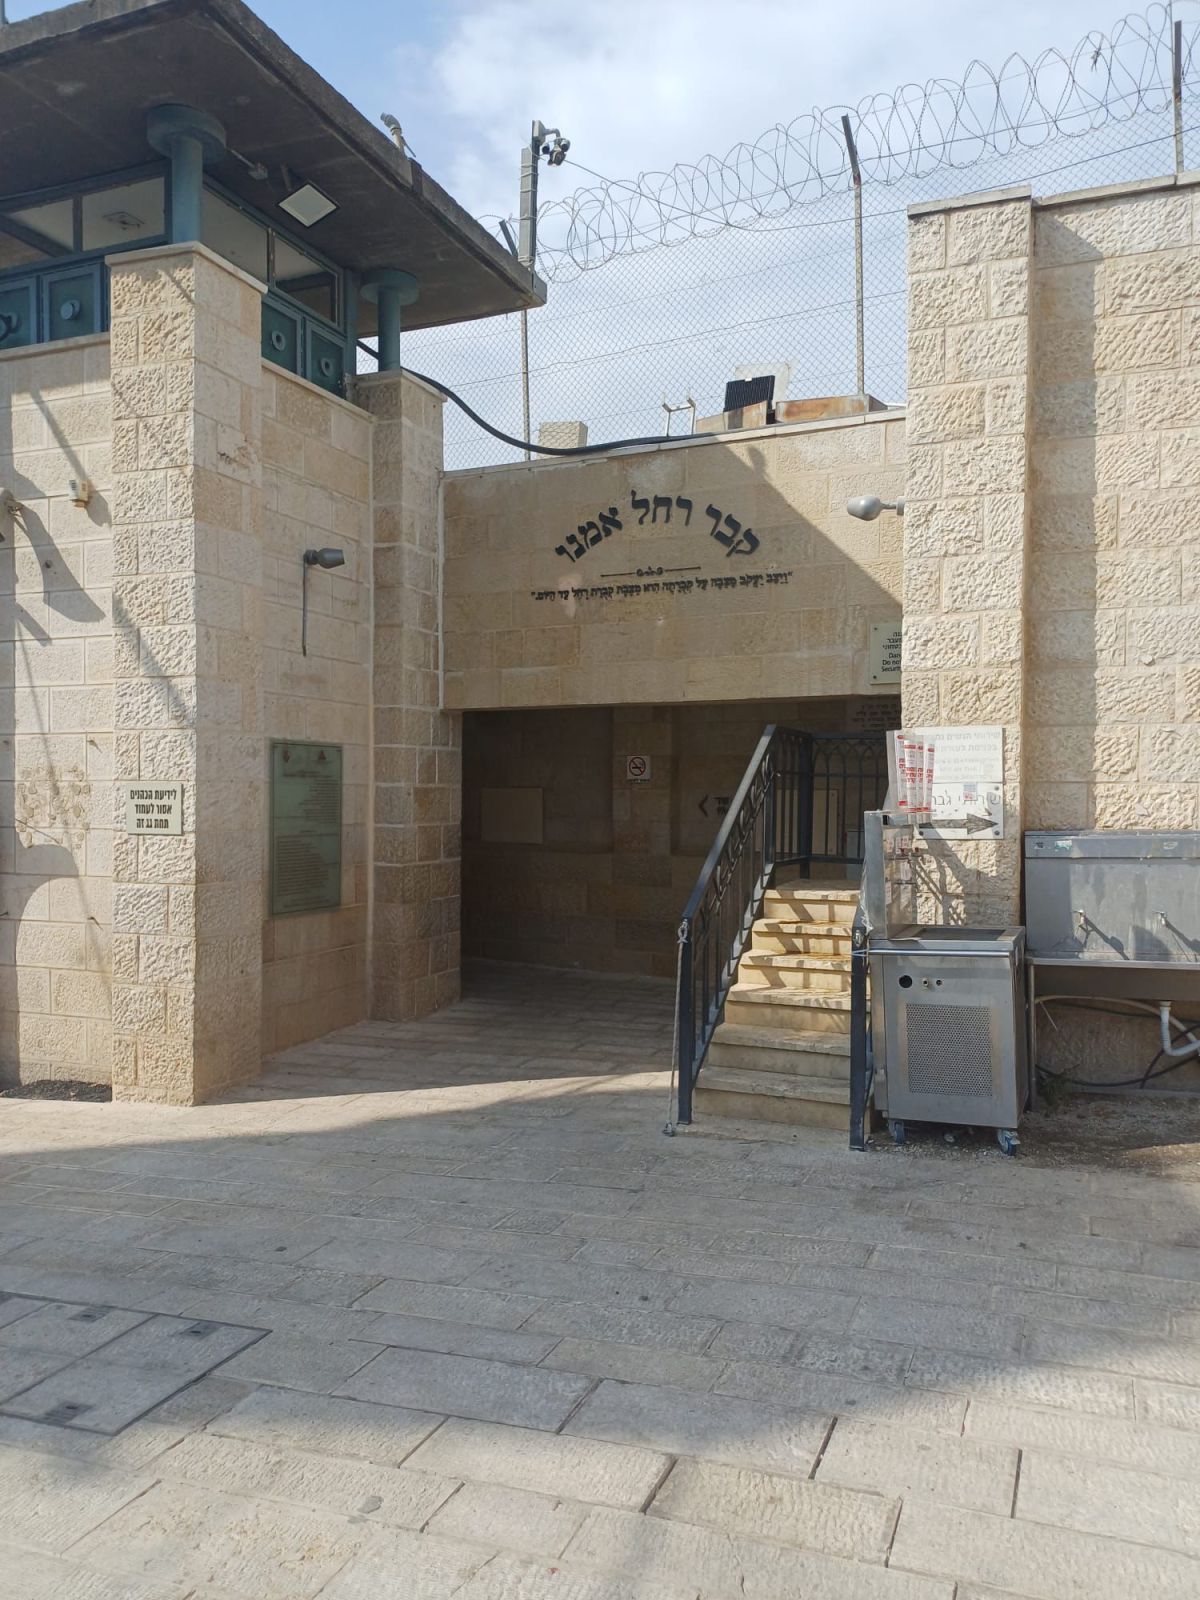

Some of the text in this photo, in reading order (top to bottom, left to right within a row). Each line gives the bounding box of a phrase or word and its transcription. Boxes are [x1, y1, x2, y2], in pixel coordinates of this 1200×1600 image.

[555, 490, 760, 562] קבר רחל אמנו
[130, 789, 177, 800] לידיעת הכהנים
[135, 803, 172, 814] אסור לעמוד
[136, 819, 169, 829] תחת גג זה
